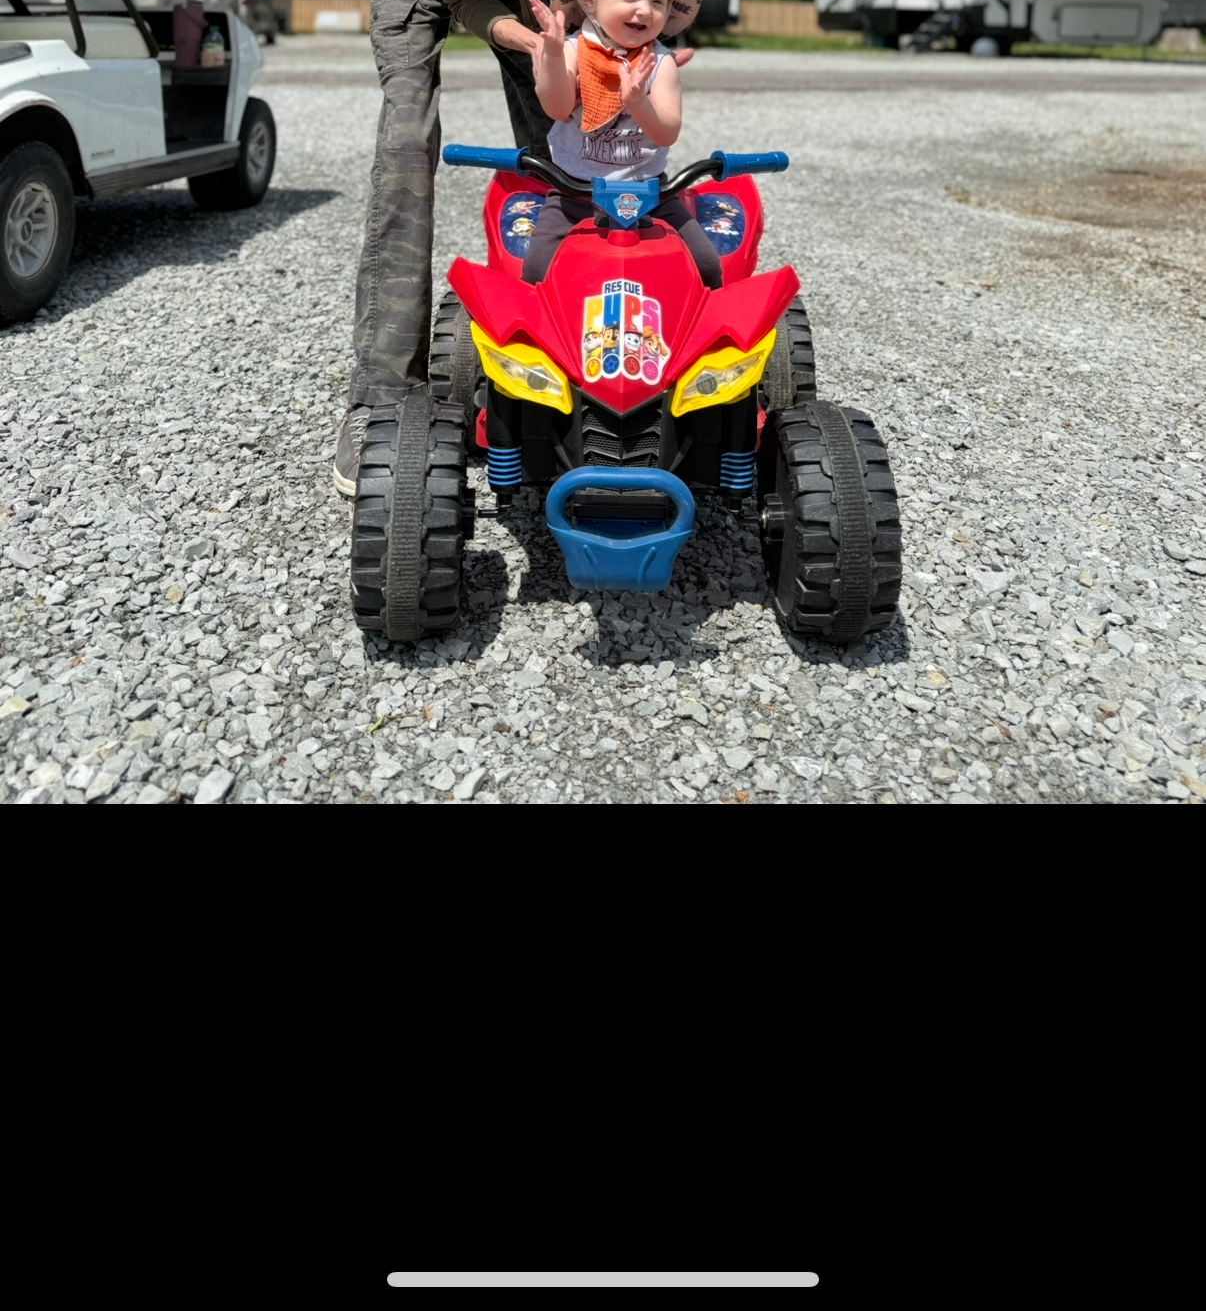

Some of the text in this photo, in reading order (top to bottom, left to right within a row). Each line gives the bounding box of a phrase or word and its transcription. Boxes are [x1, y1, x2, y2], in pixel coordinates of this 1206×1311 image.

[579, 135, 644, 161] ADVENTURE
[604, 280, 640, 296] RESCUE
[586, 293, 659, 335] PUPS
